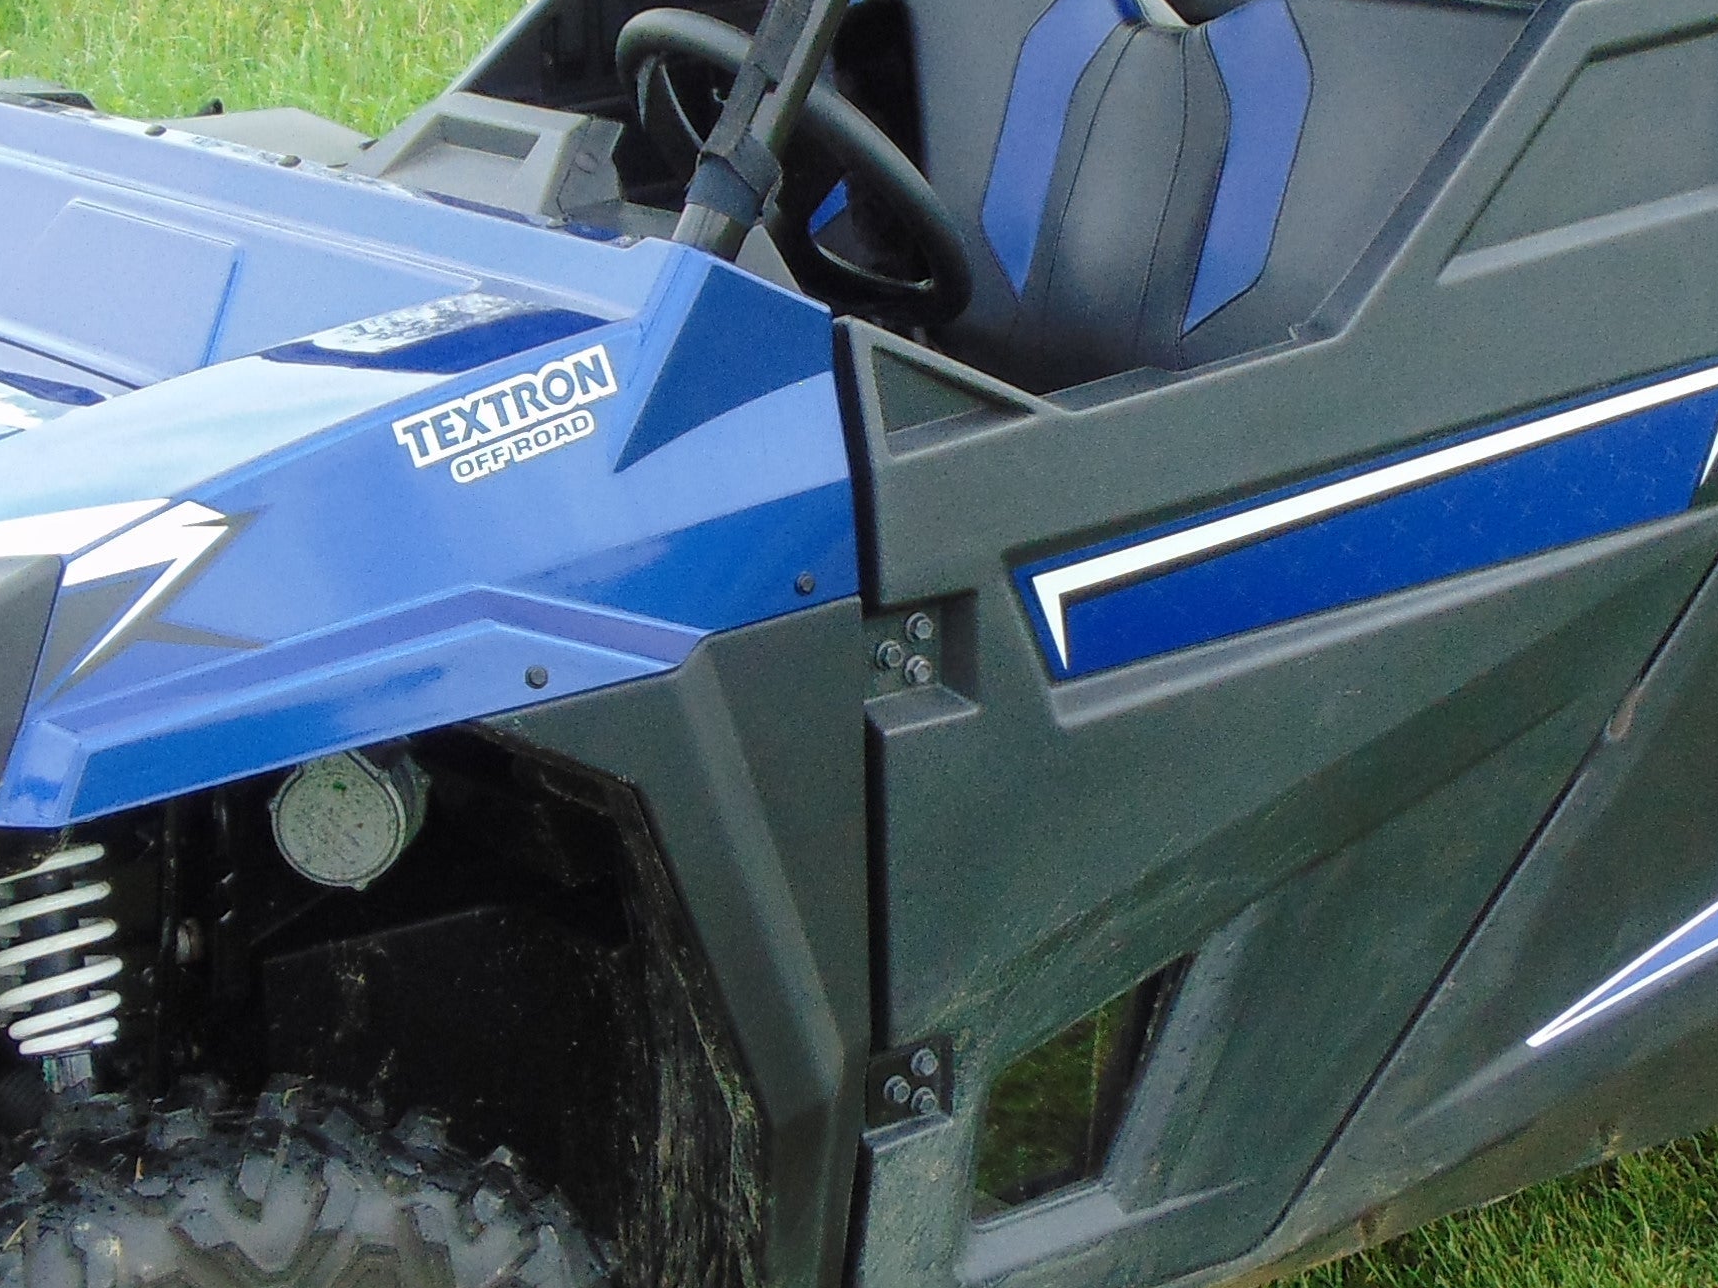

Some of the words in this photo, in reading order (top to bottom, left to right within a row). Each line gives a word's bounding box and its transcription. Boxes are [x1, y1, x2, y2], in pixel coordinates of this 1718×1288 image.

[401, 353, 608, 459] TEXTRON
[455, 444, 506, 478] OFF
[512, 414, 590, 456] ROAD
